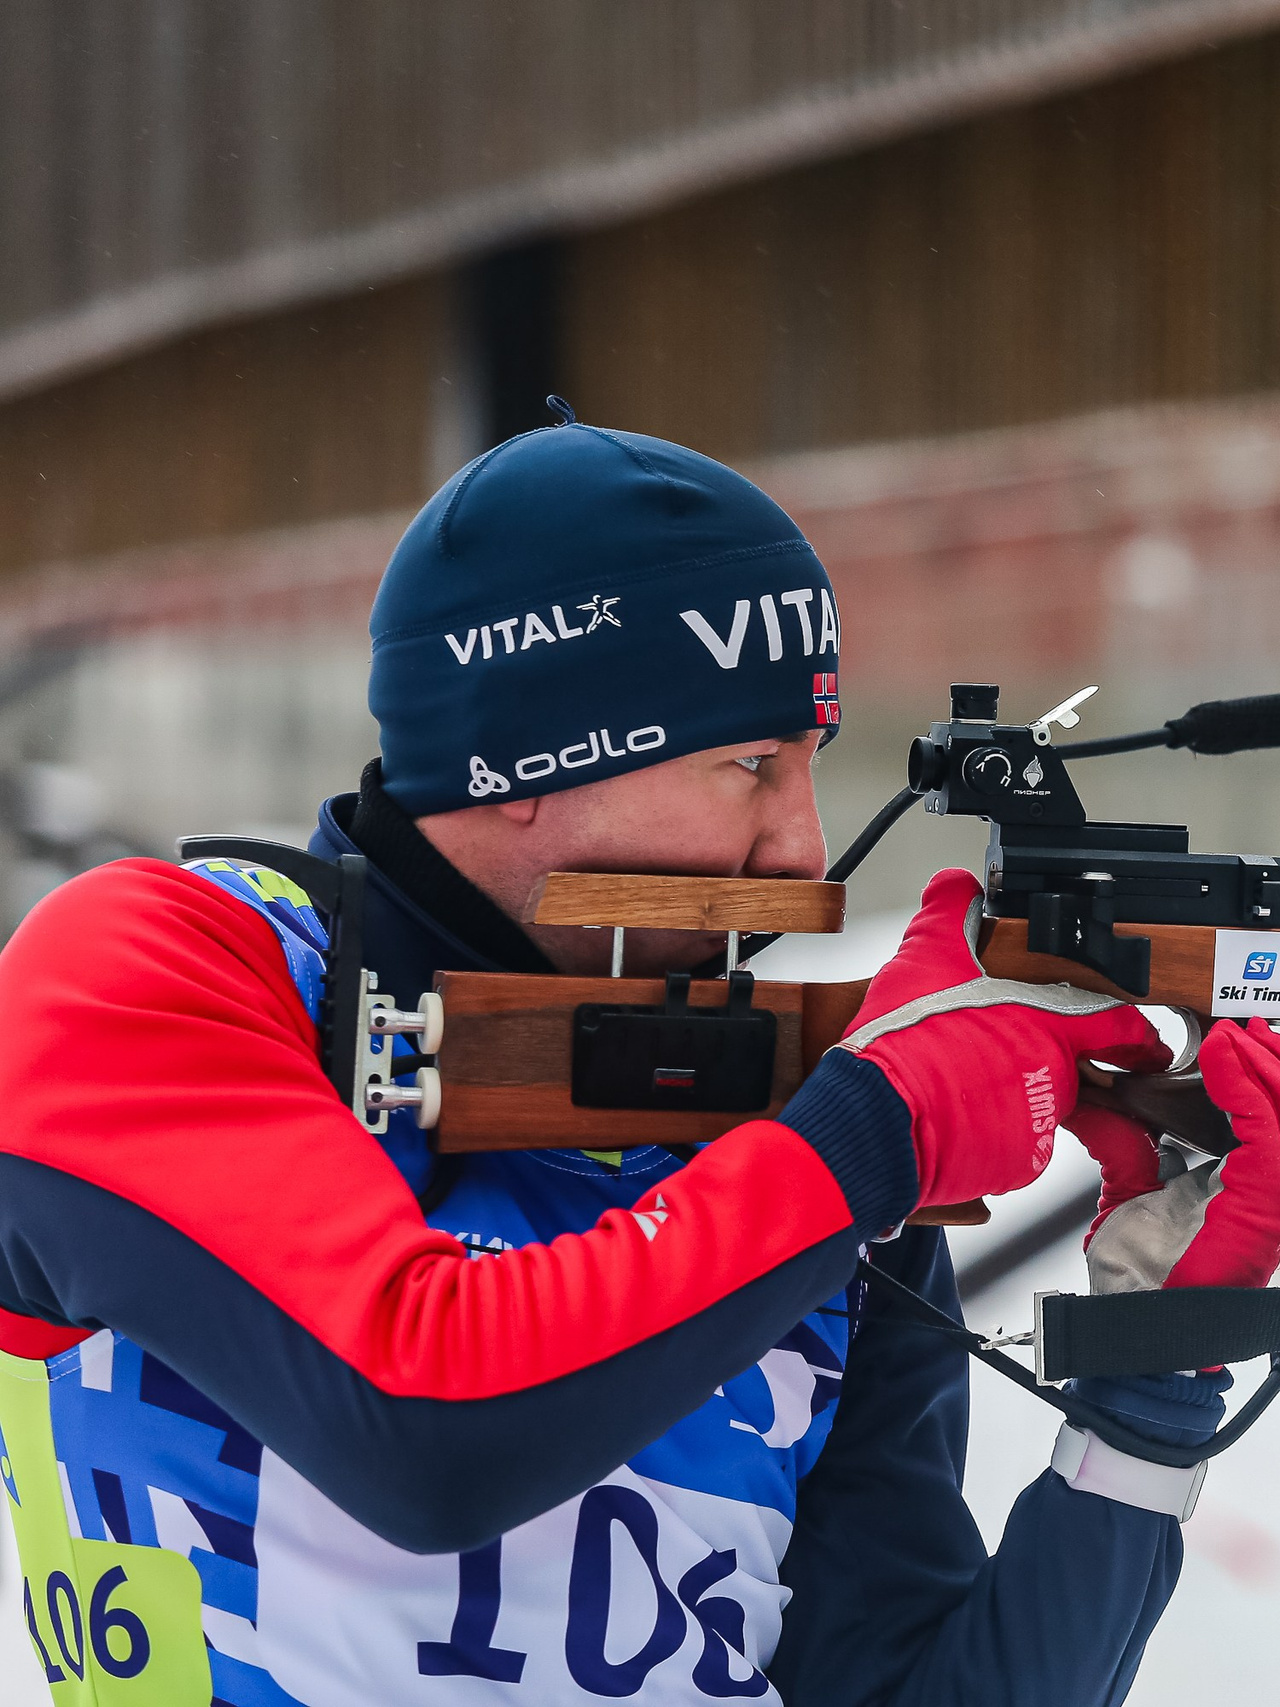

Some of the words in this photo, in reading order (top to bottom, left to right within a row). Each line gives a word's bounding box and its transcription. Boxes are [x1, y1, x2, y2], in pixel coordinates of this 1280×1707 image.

[444, 605, 583, 665] VITAL
[679, 588, 841, 670] VITA
[515, 725, 667, 781] odlo
[1219, 986, 1247, 1001] Ski
[1022, 1065, 1056, 1134] SWIX
[23, 1563, 150, 1684] 106
[417, 1484, 771, 1699] 106
